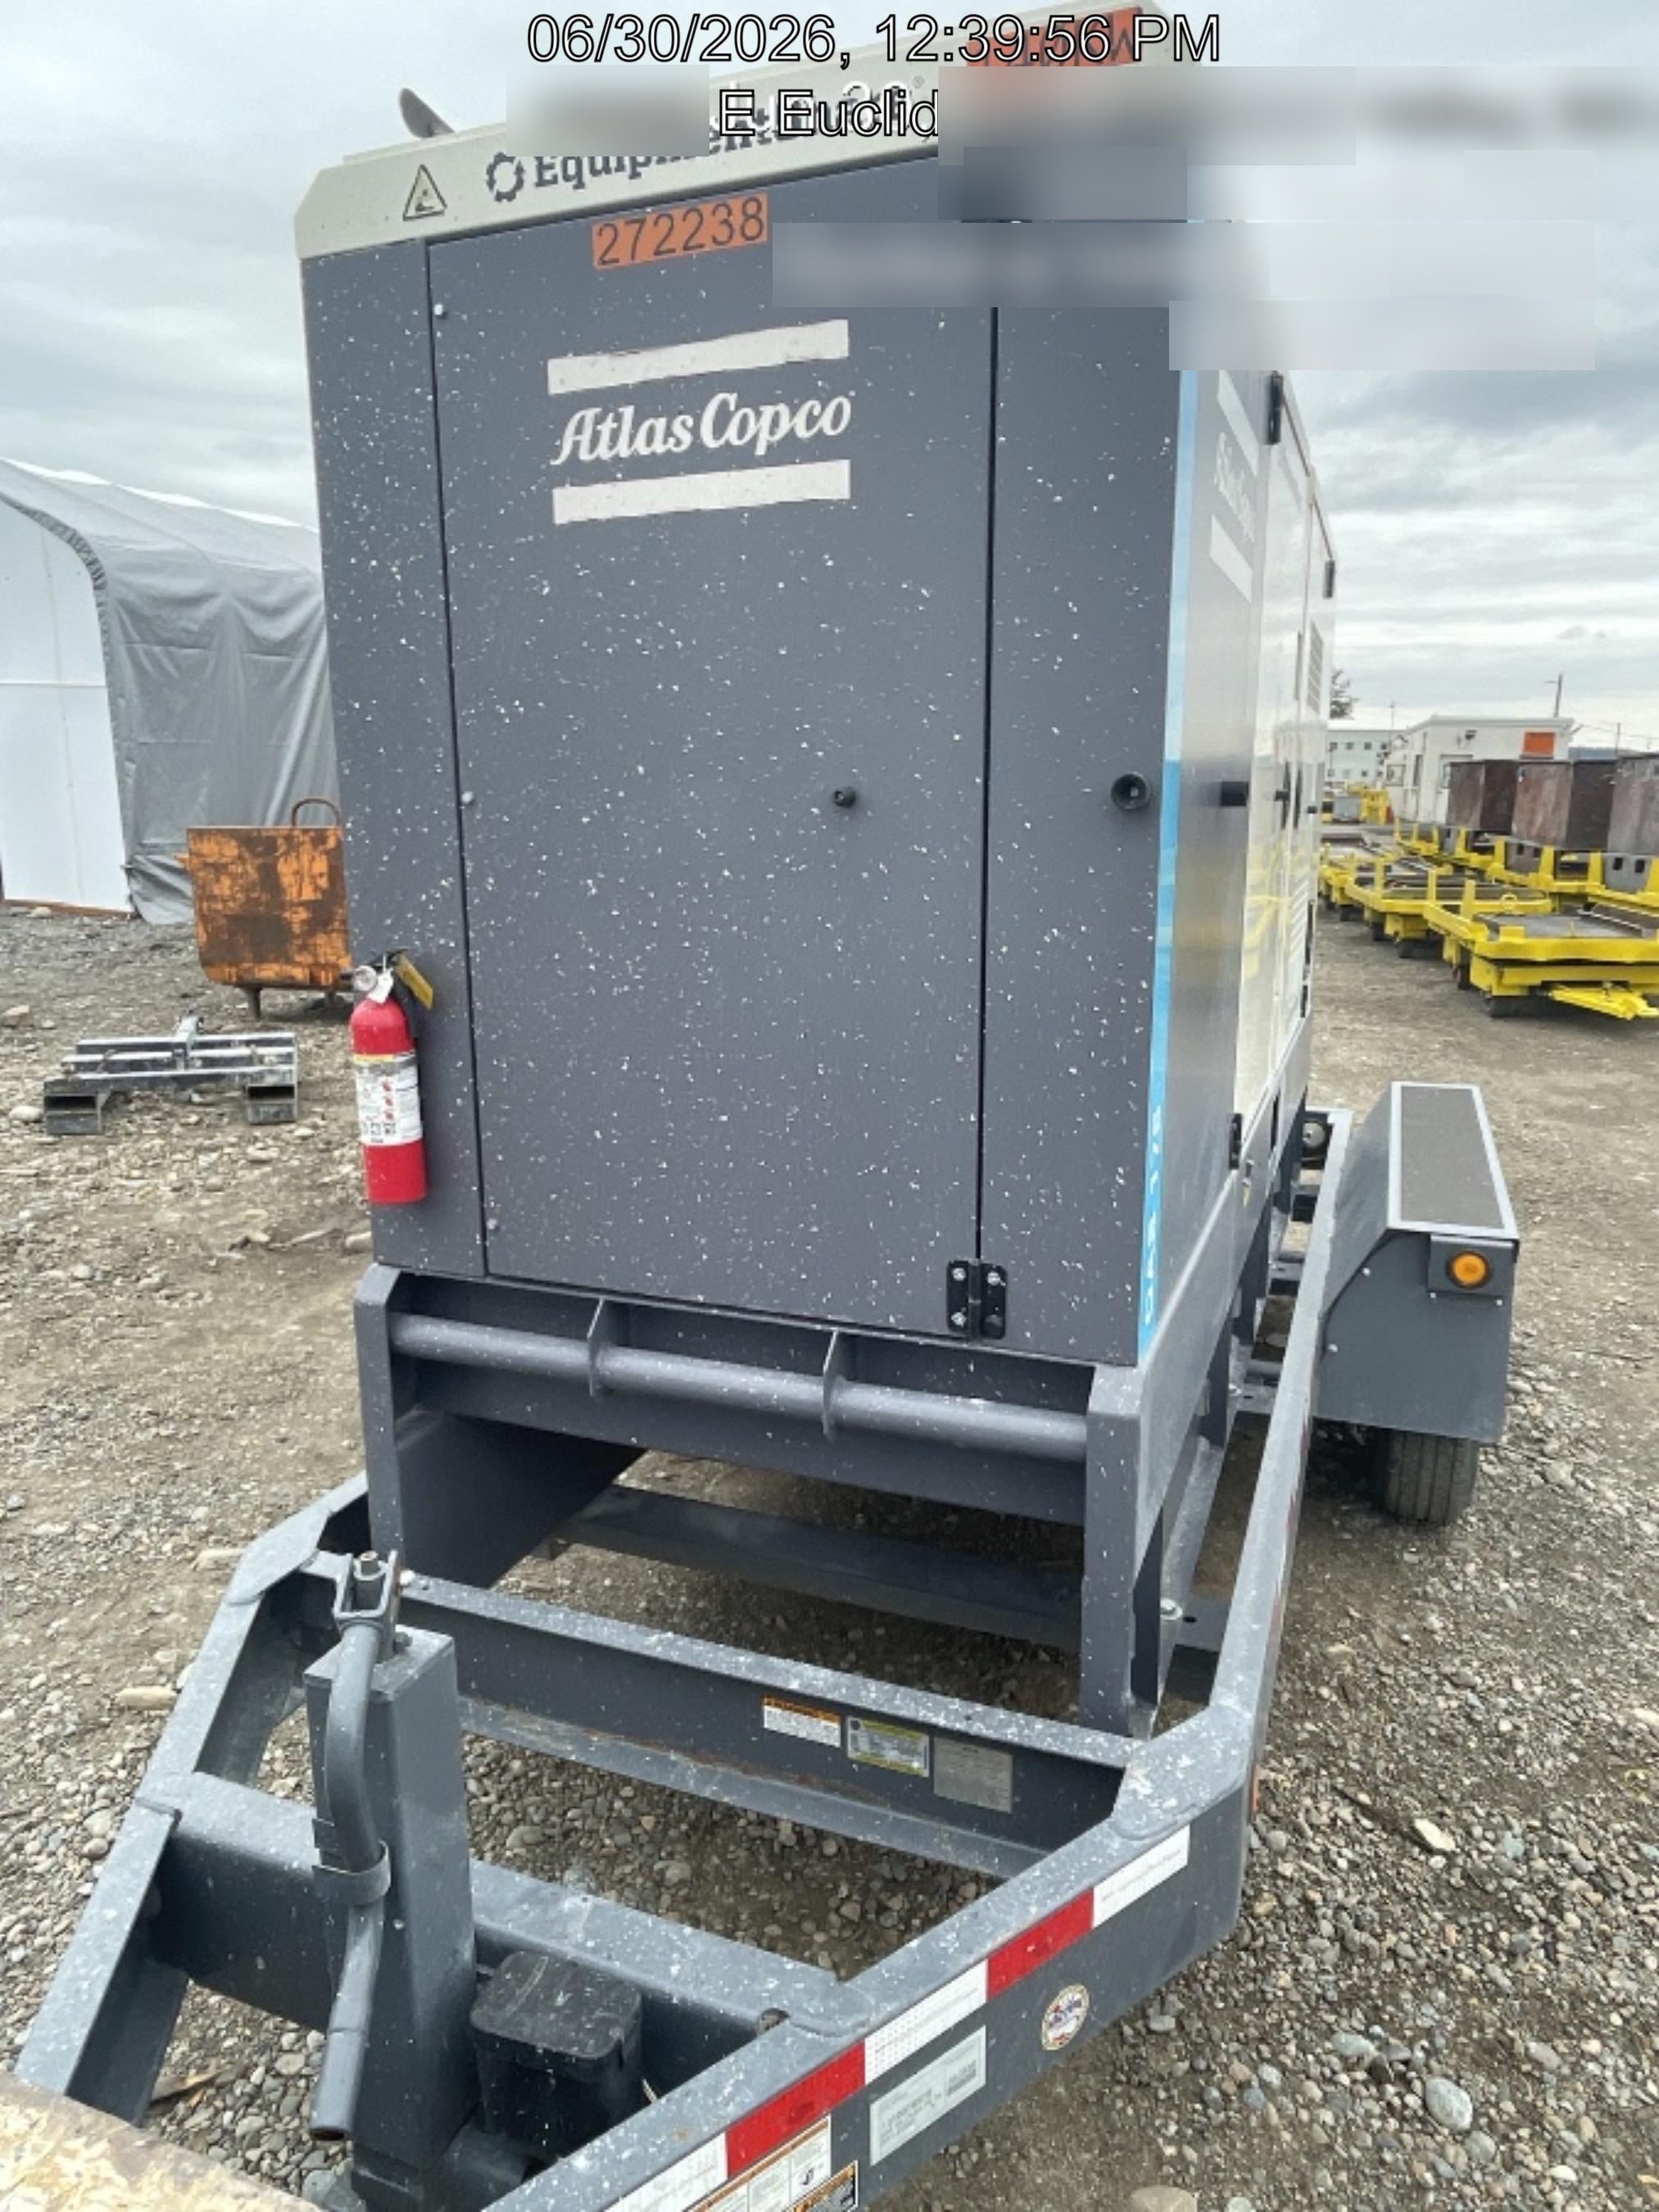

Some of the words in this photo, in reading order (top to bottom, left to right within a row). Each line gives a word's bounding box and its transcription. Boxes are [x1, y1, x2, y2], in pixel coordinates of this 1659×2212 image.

[596, 196, 764, 266] 272238
[550, 405, 694, 465] Atlas
[700, 392, 852, 456] Copco
